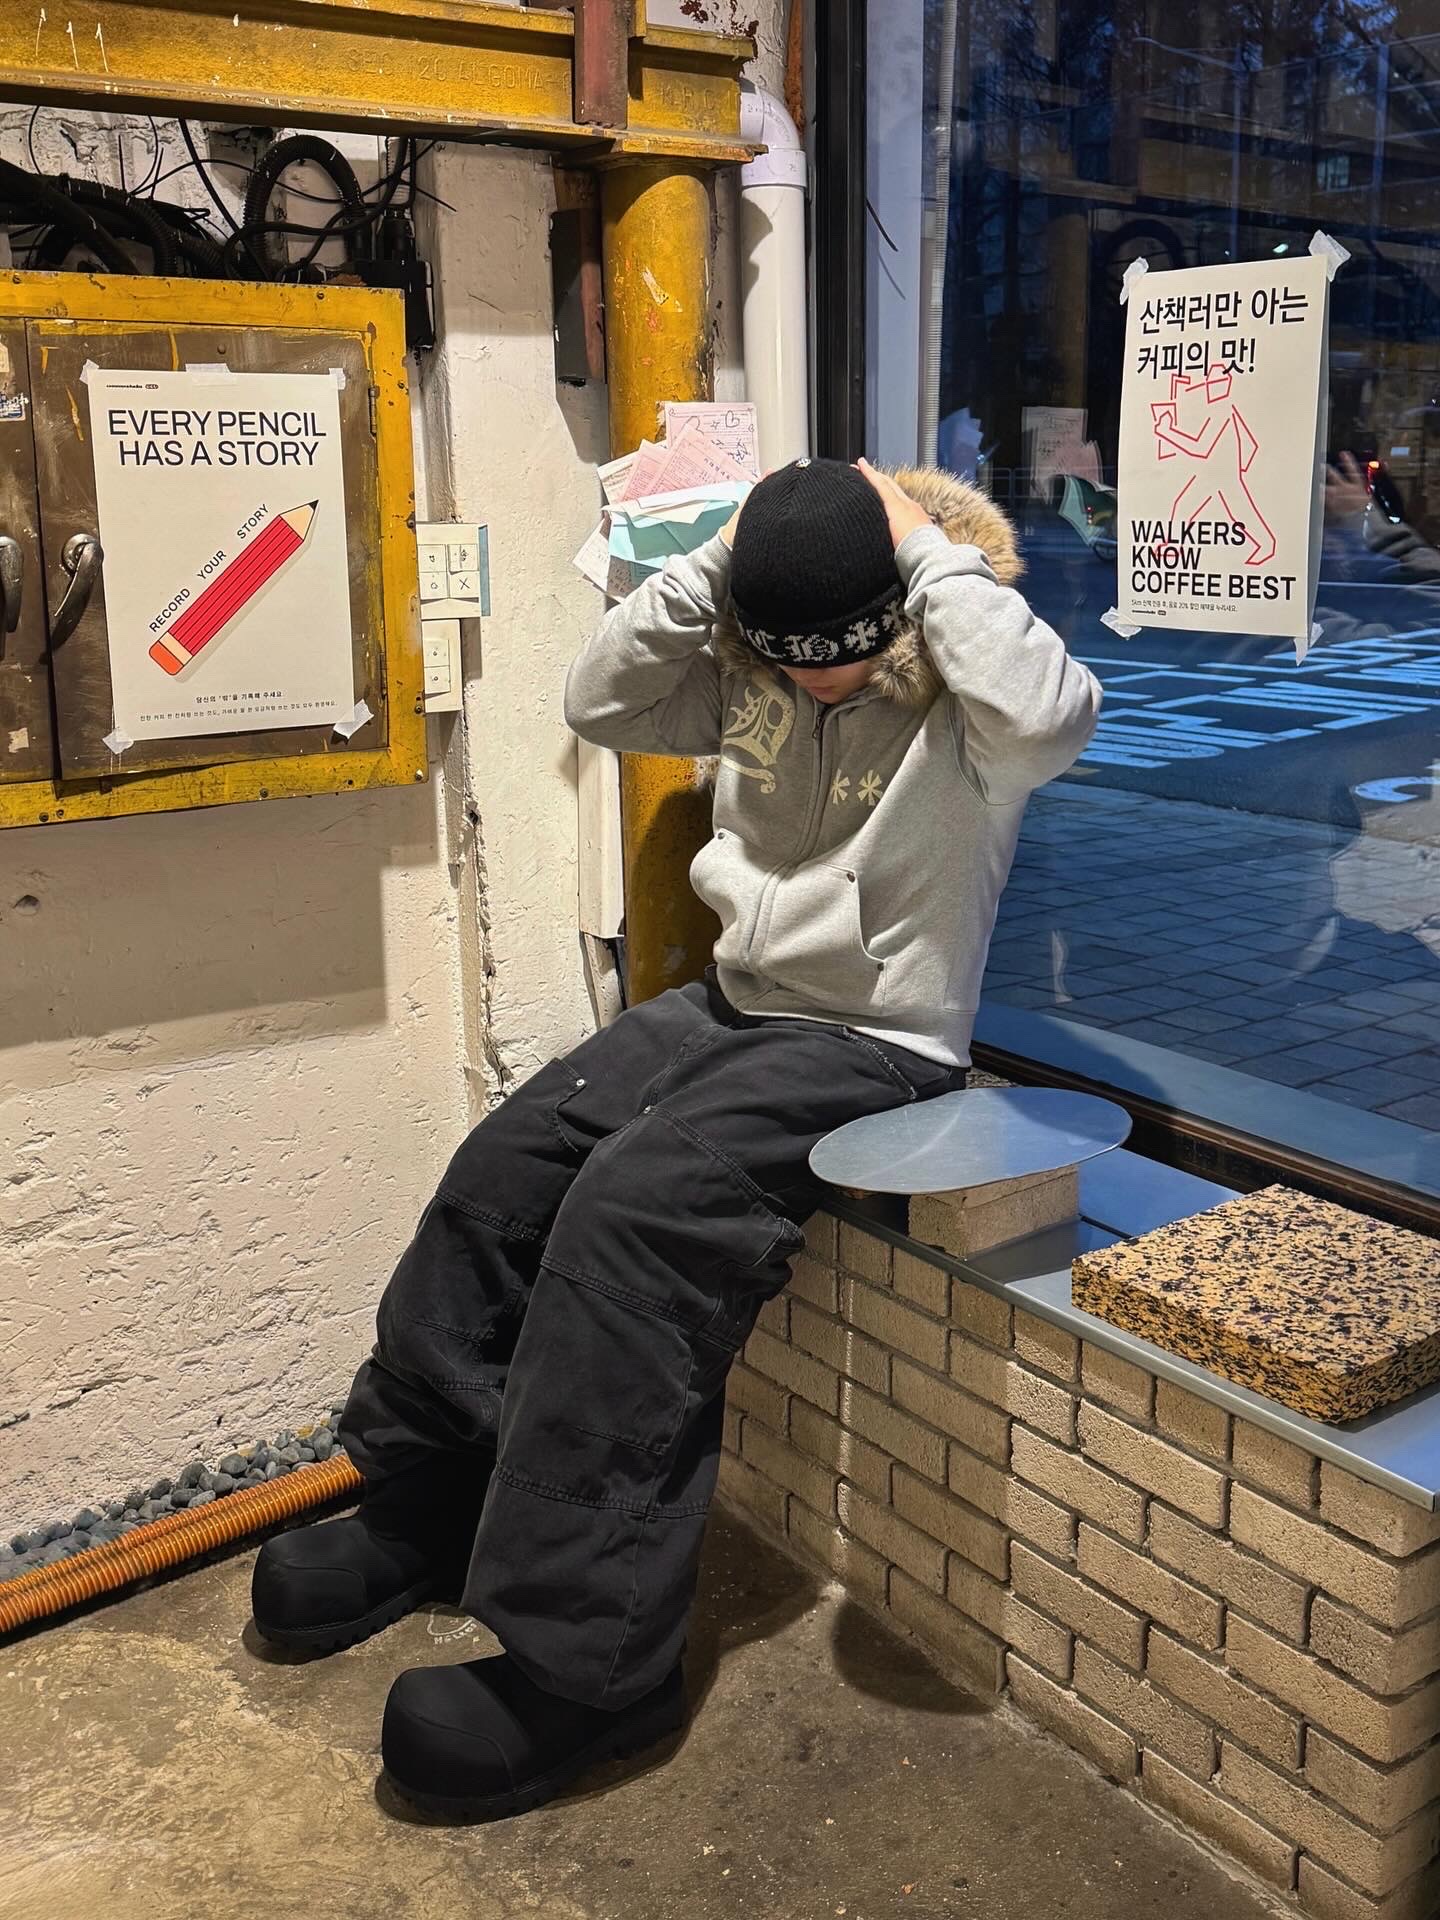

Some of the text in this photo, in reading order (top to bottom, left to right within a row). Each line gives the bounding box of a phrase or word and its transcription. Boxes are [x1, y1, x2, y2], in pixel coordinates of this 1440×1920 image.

[1139, 286, 1308, 334] 산책러만 아는
[1137, 338, 1256, 379] 커피의 맛!
[108, 409, 326, 437] EVERY PENCIL
[119, 440, 319, 466] HAS A STORY
[1131, 520, 1246, 546] WALKERS
[149, 503, 269, 633] RECORD YOUR STORY
[1132, 545, 1202, 570] KNOW
[1131, 570, 1296, 600] COFFEE BEST
[263, 690, 282, 699] 주세요
